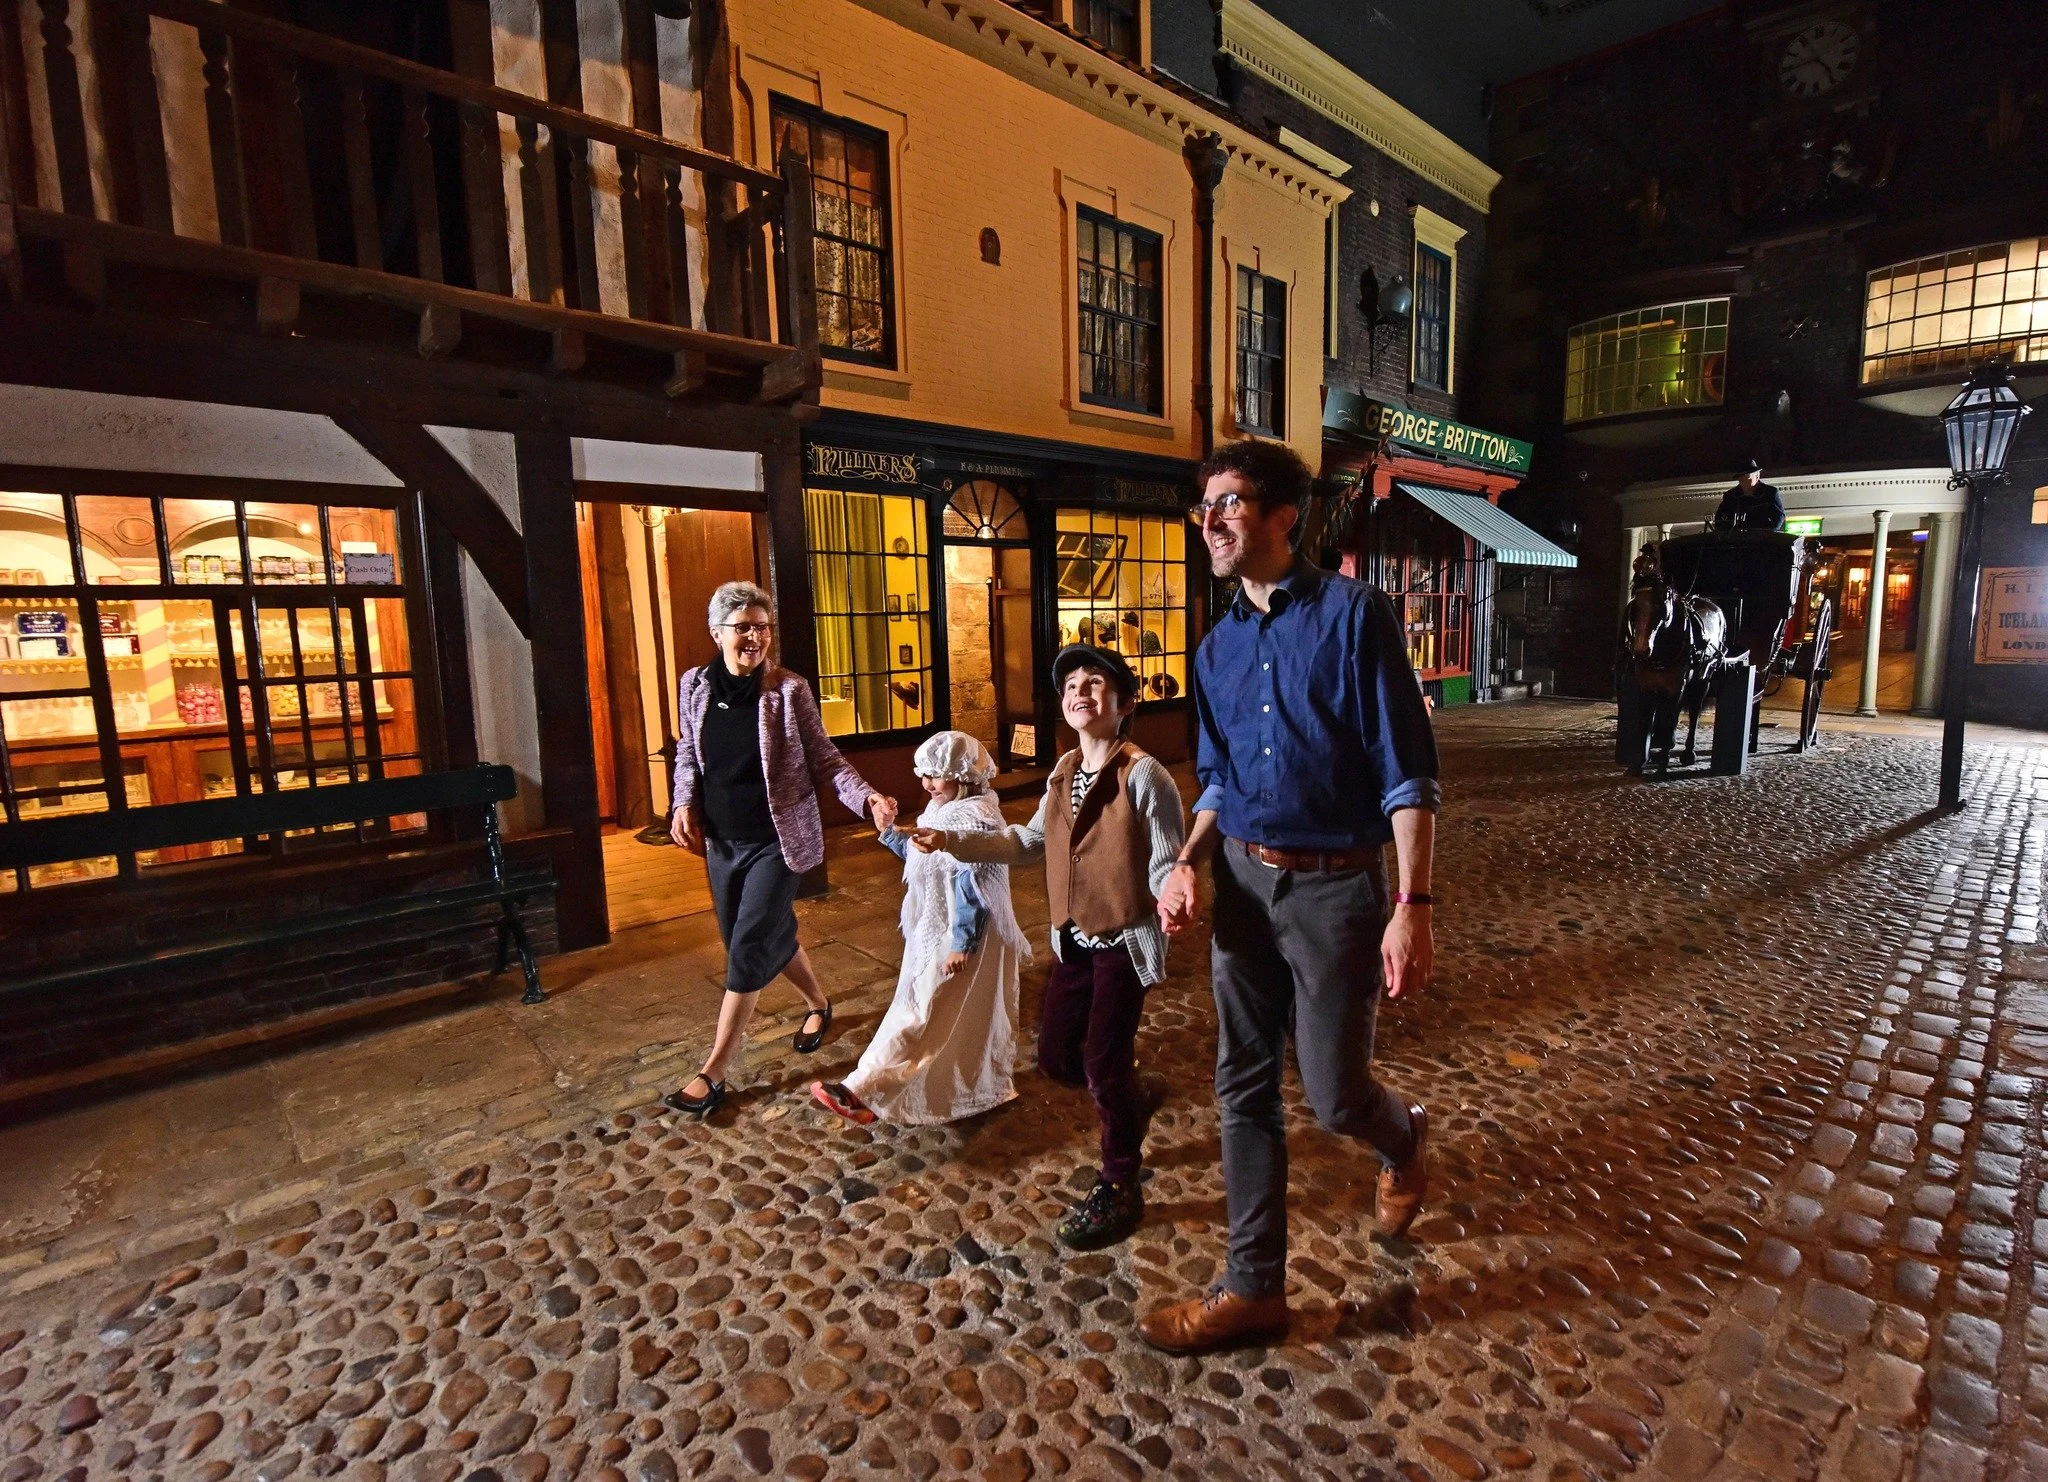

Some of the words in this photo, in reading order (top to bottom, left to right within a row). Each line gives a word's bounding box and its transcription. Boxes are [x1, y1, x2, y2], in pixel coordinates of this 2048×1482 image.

[1366, 404, 1439, 446] GEORGE
[1443, 424, 1509, 463] BRITTON
[812, 443, 918, 484] MILLINERS
[349, 565, 368, 573] Cash
[370, 565, 388, 575] Only
[2002, 641, 2048, 650] LOND
